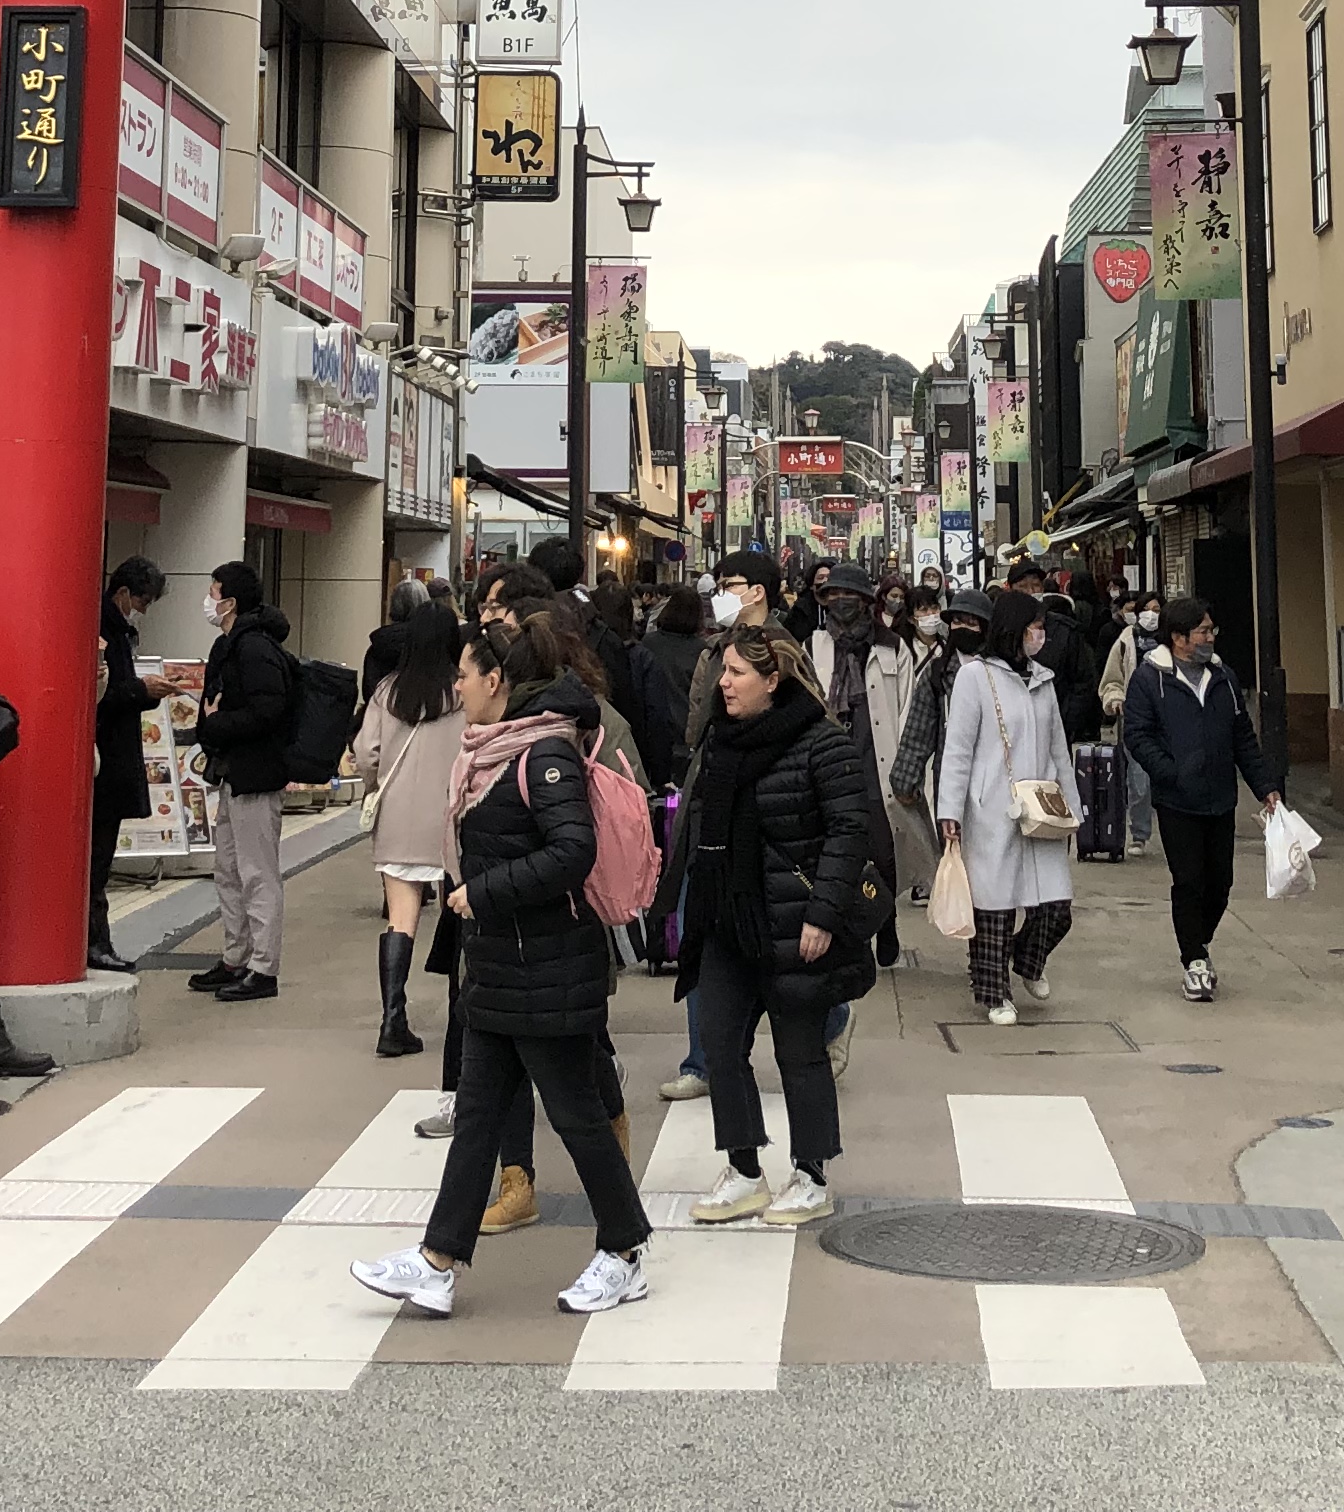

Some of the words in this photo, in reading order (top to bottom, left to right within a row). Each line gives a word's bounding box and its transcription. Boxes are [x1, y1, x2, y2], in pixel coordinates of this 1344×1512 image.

[503, 38, 534, 53] B1F
[16, 26, 65, 185] 小町通り
[482, 119, 543, 173] わん
[1106, 258, 1139, 271] いちご
[788, 452, 835, 466] 小町通り
